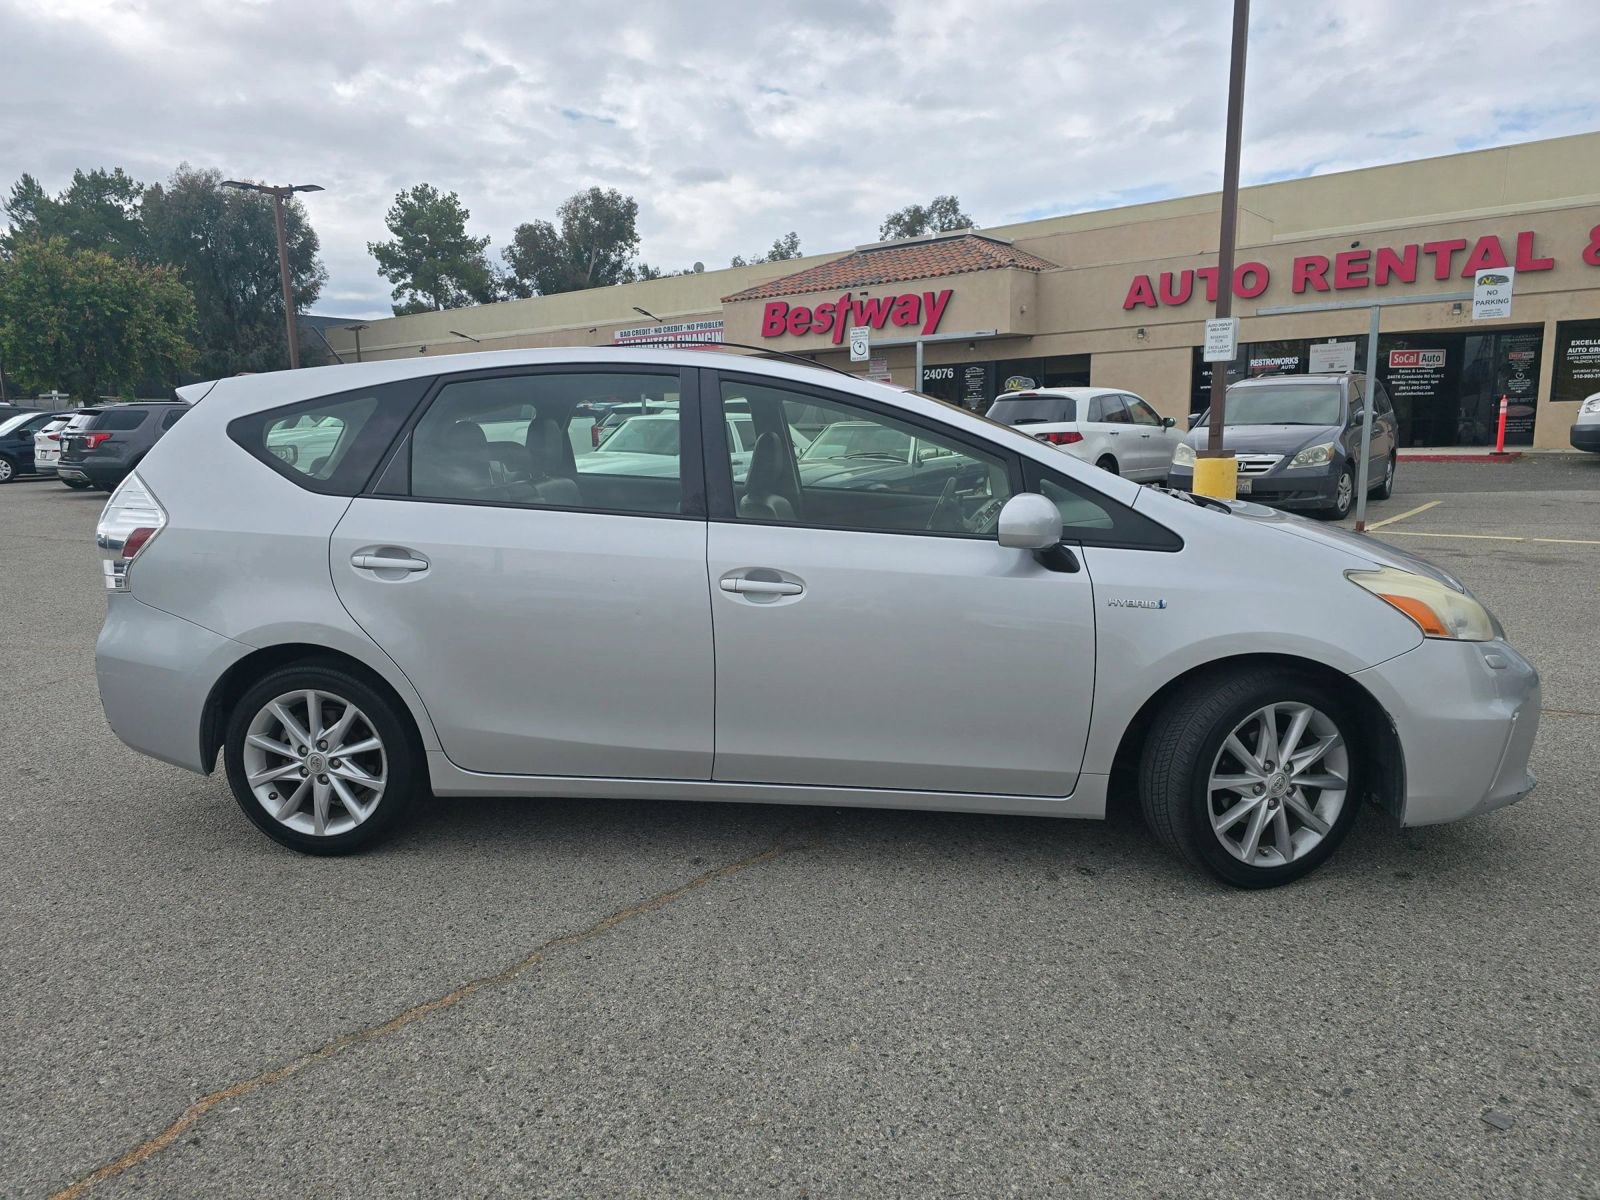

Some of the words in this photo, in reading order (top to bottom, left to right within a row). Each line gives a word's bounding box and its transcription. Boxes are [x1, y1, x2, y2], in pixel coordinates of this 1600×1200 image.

[1123, 262, 1269, 310] AUTO
[1292, 231, 1554, 294] RENTAL
[1475, 297, 1510, 307] PARKING
[761, 289, 953, 345] Bestway
[620, 330, 631, 338] BAD
[632, 328, 651, 337] CREDIT
[654, 326, 663, 334] NO
[663, 325, 683, 333] CREDIT
[686, 323, 695, 331] NO
[696, 320, 724, 330] PROBLEM
[677, 331, 725, 348] FINANCIN
[1250, 356, 1299, 367] RESTROWORKS
[1394, 353, 1417, 363] SoCal
[1421, 353, 1441, 363] Auto
[923, 368, 954, 380] 24076
[1107, 598, 1158, 608] HYBRID
